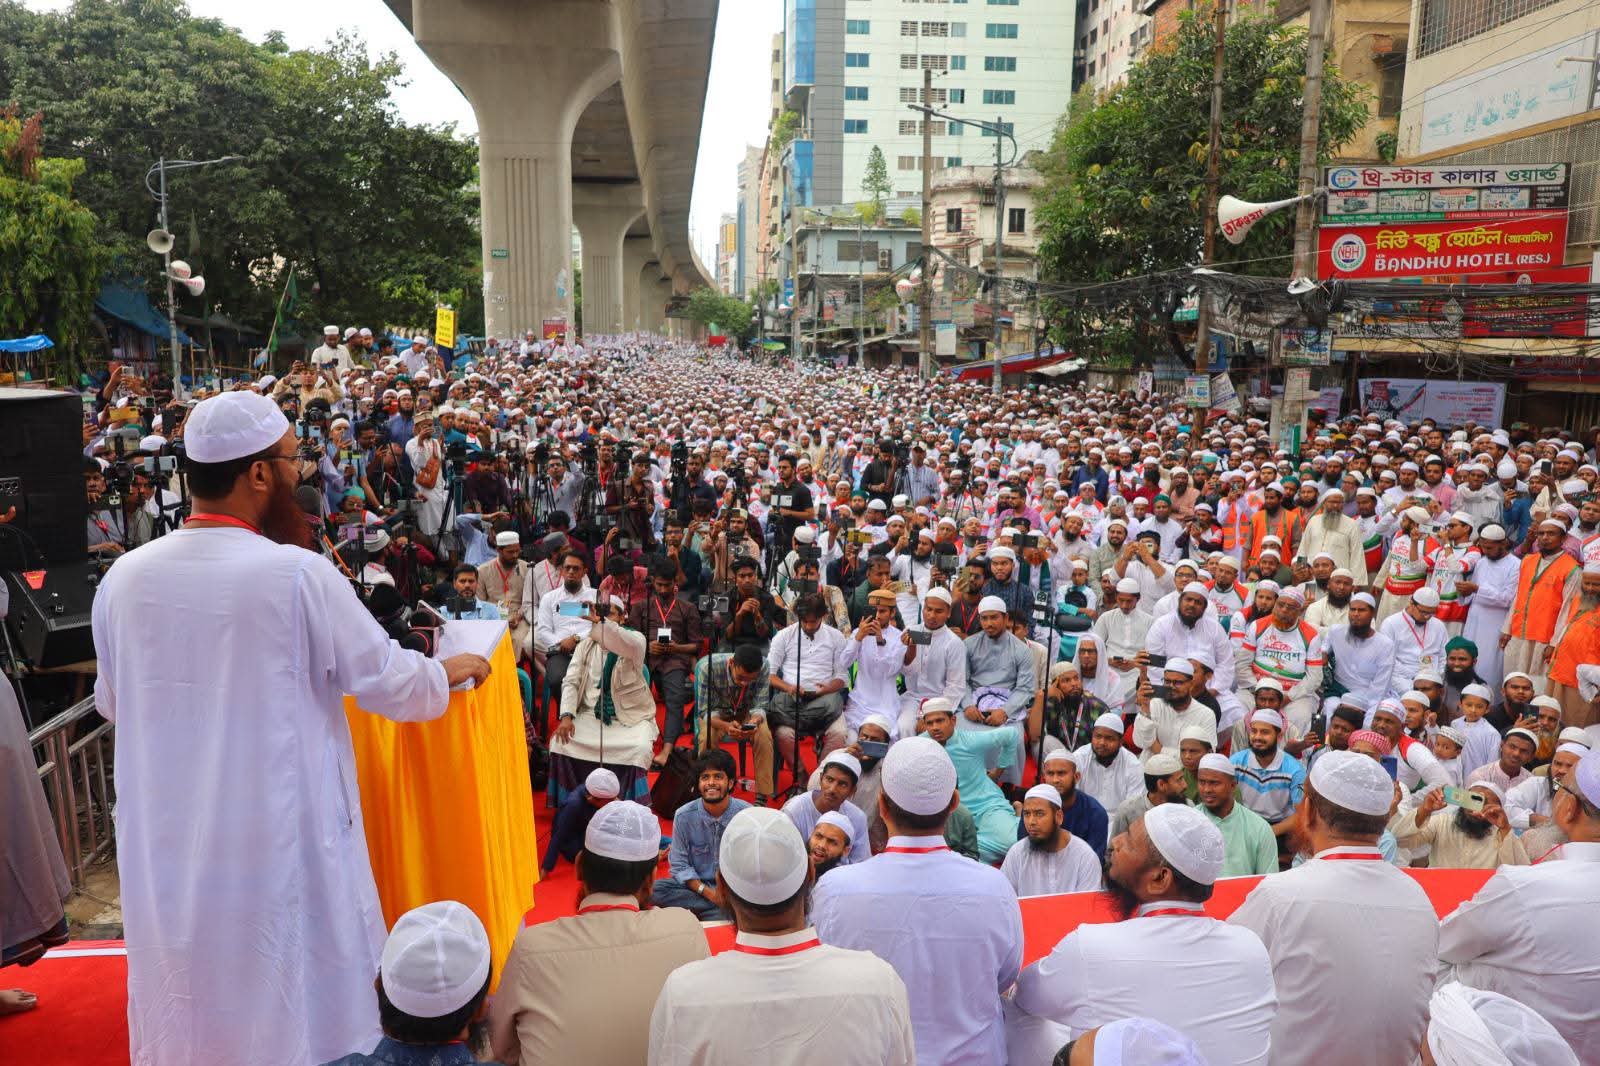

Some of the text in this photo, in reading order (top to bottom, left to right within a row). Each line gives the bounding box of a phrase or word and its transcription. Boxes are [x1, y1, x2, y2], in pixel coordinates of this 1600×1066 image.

[1440, 168, 1497, 184] কালার
[1376, 230, 1410, 250] নিউ
[1446, 228, 1503, 247] হোটেল
[1337, 243, 1361, 259] NBH
[1375, 253, 1551, 272] BANDHU HOTEL (RES.)
